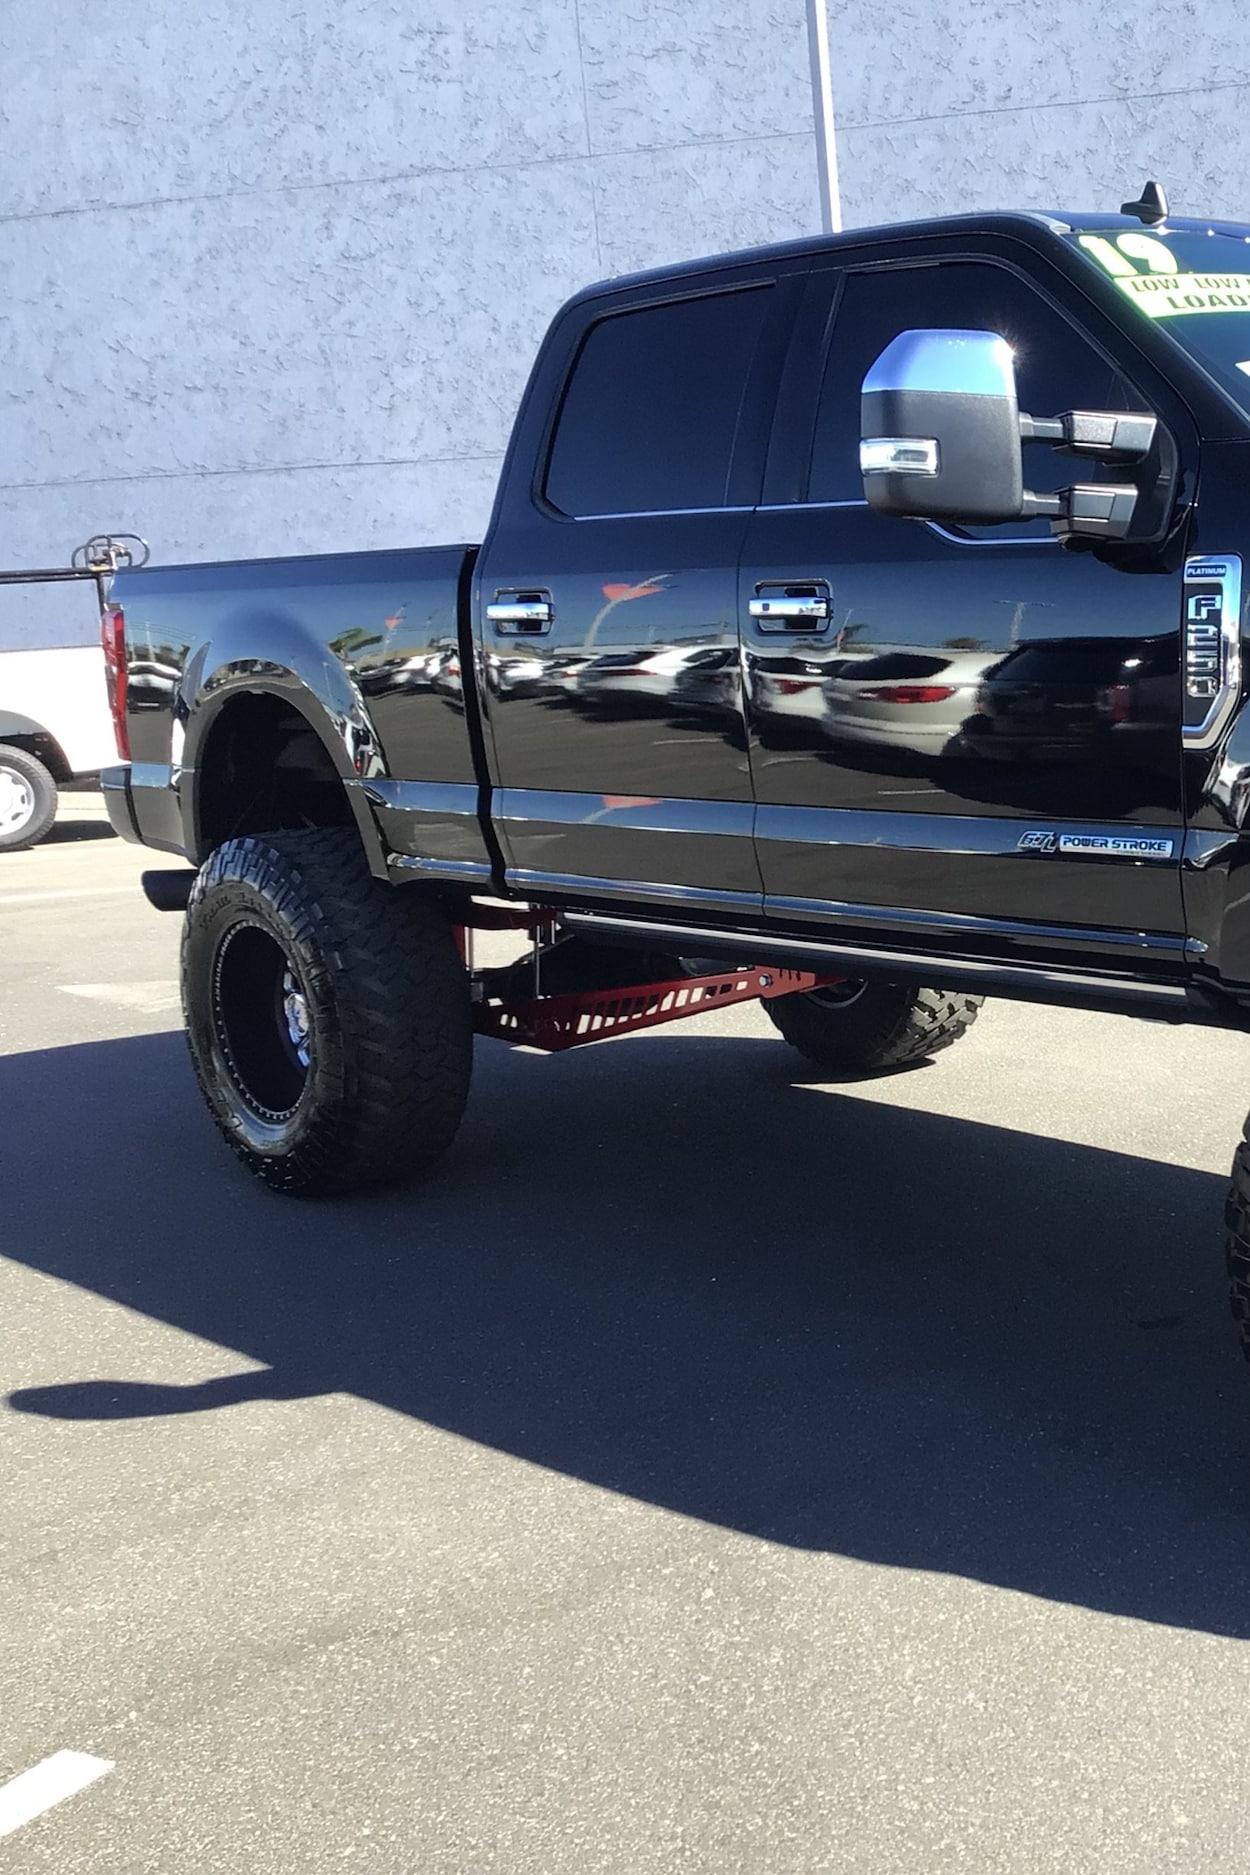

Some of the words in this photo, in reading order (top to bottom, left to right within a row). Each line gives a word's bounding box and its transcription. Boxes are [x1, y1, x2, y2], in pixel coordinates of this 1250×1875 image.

[1078, 233, 1178, 275] 19
[1194, 277, 1242, 290] LOW
[1187, 566, 1226, 576] PLATINUM
[1063, 837, 1109, 848] POWER
[1111, 839, 1167, 851] STROKE
